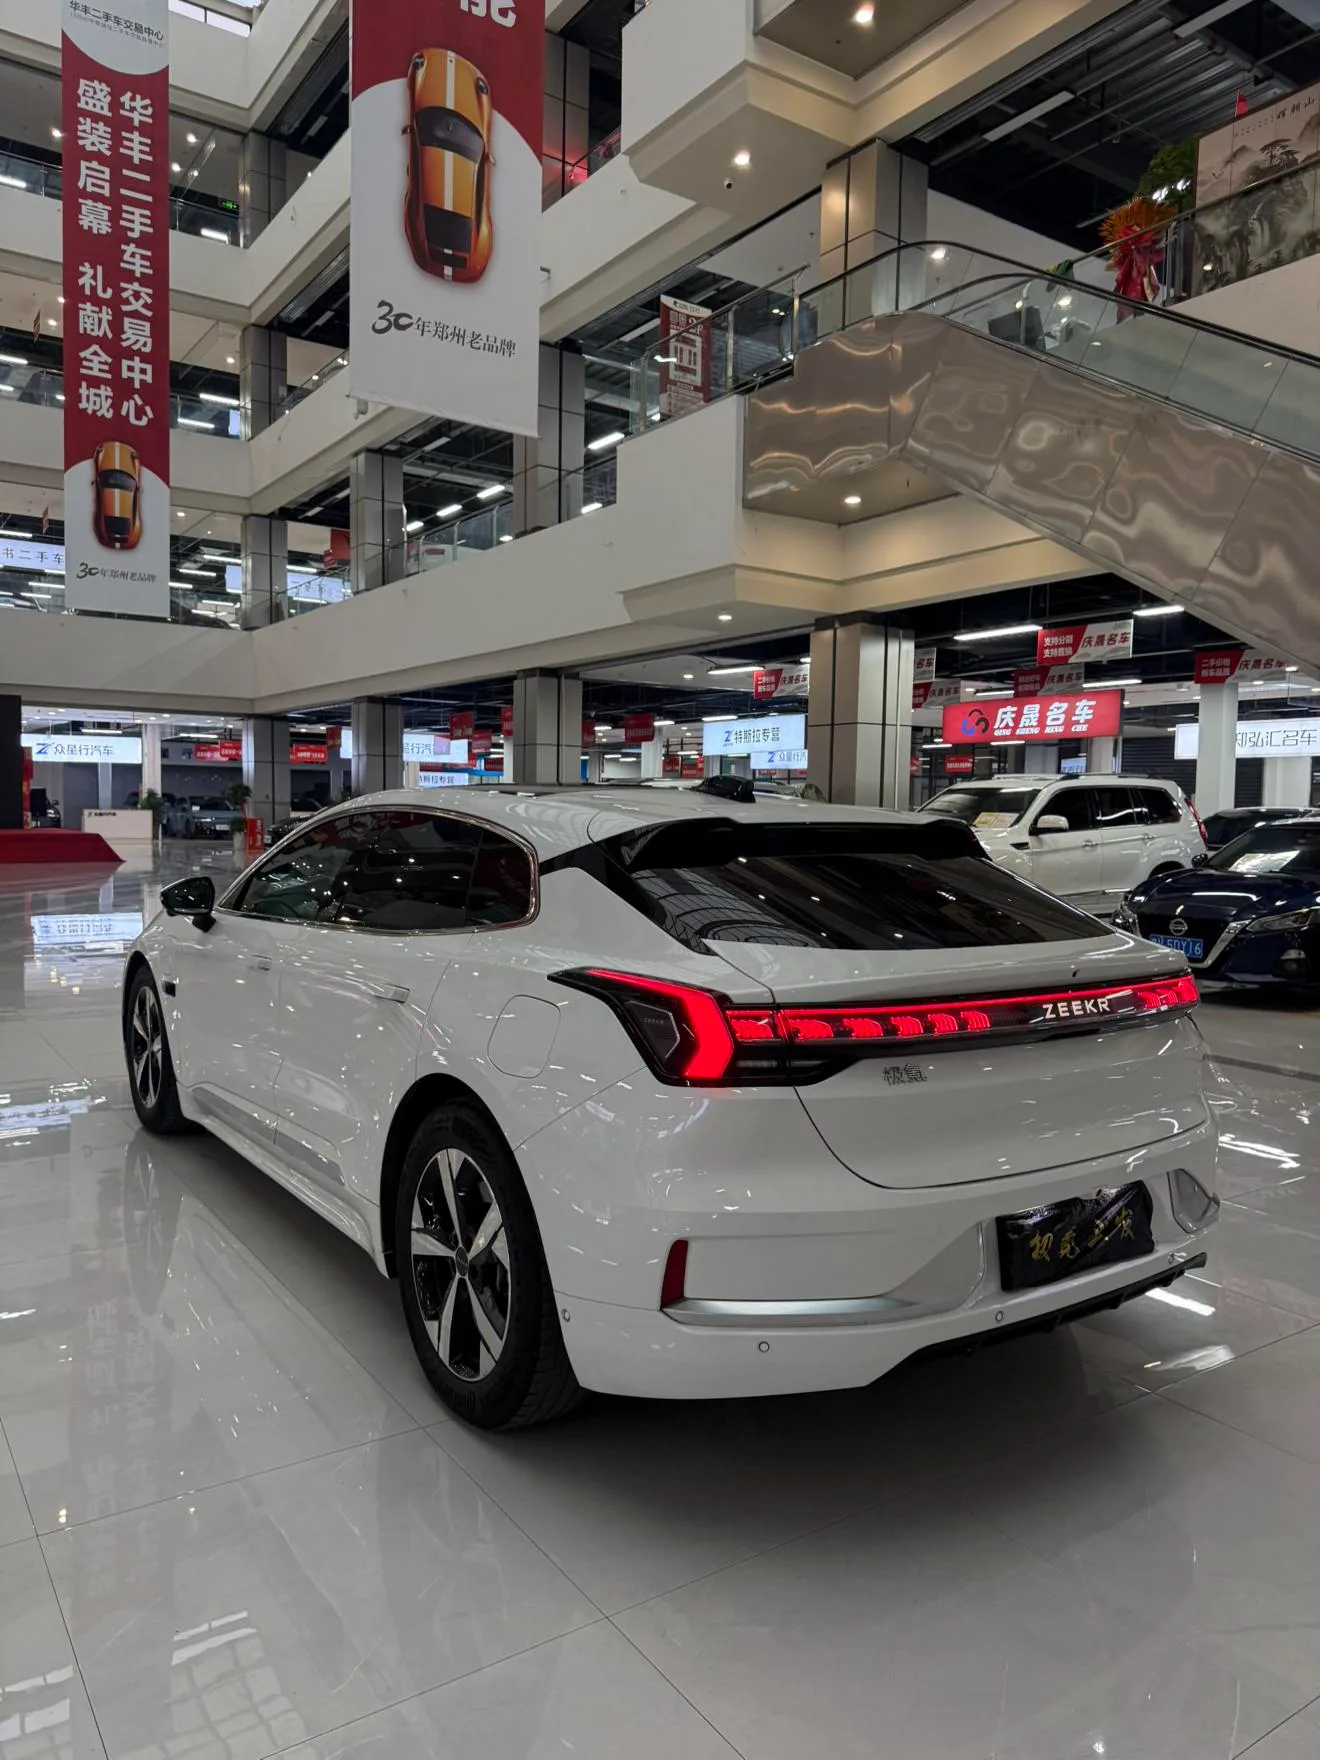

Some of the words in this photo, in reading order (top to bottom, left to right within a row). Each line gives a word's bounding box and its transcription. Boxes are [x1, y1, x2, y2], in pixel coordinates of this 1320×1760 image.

[70, 0, 164, 41] 华丰二手车交易中心
[77, 78, 112, 235] 盛装启幕
[119, 91, 154, 427] 华丰二手车交易中心
[78, 262, 113, 419] 礼献全城
[993, 699, 1097, 729] 庆晟名车
[54, 743, 114, 756] 众星行汽车
[1042, 998, 1112, 1020] ZEEKR
